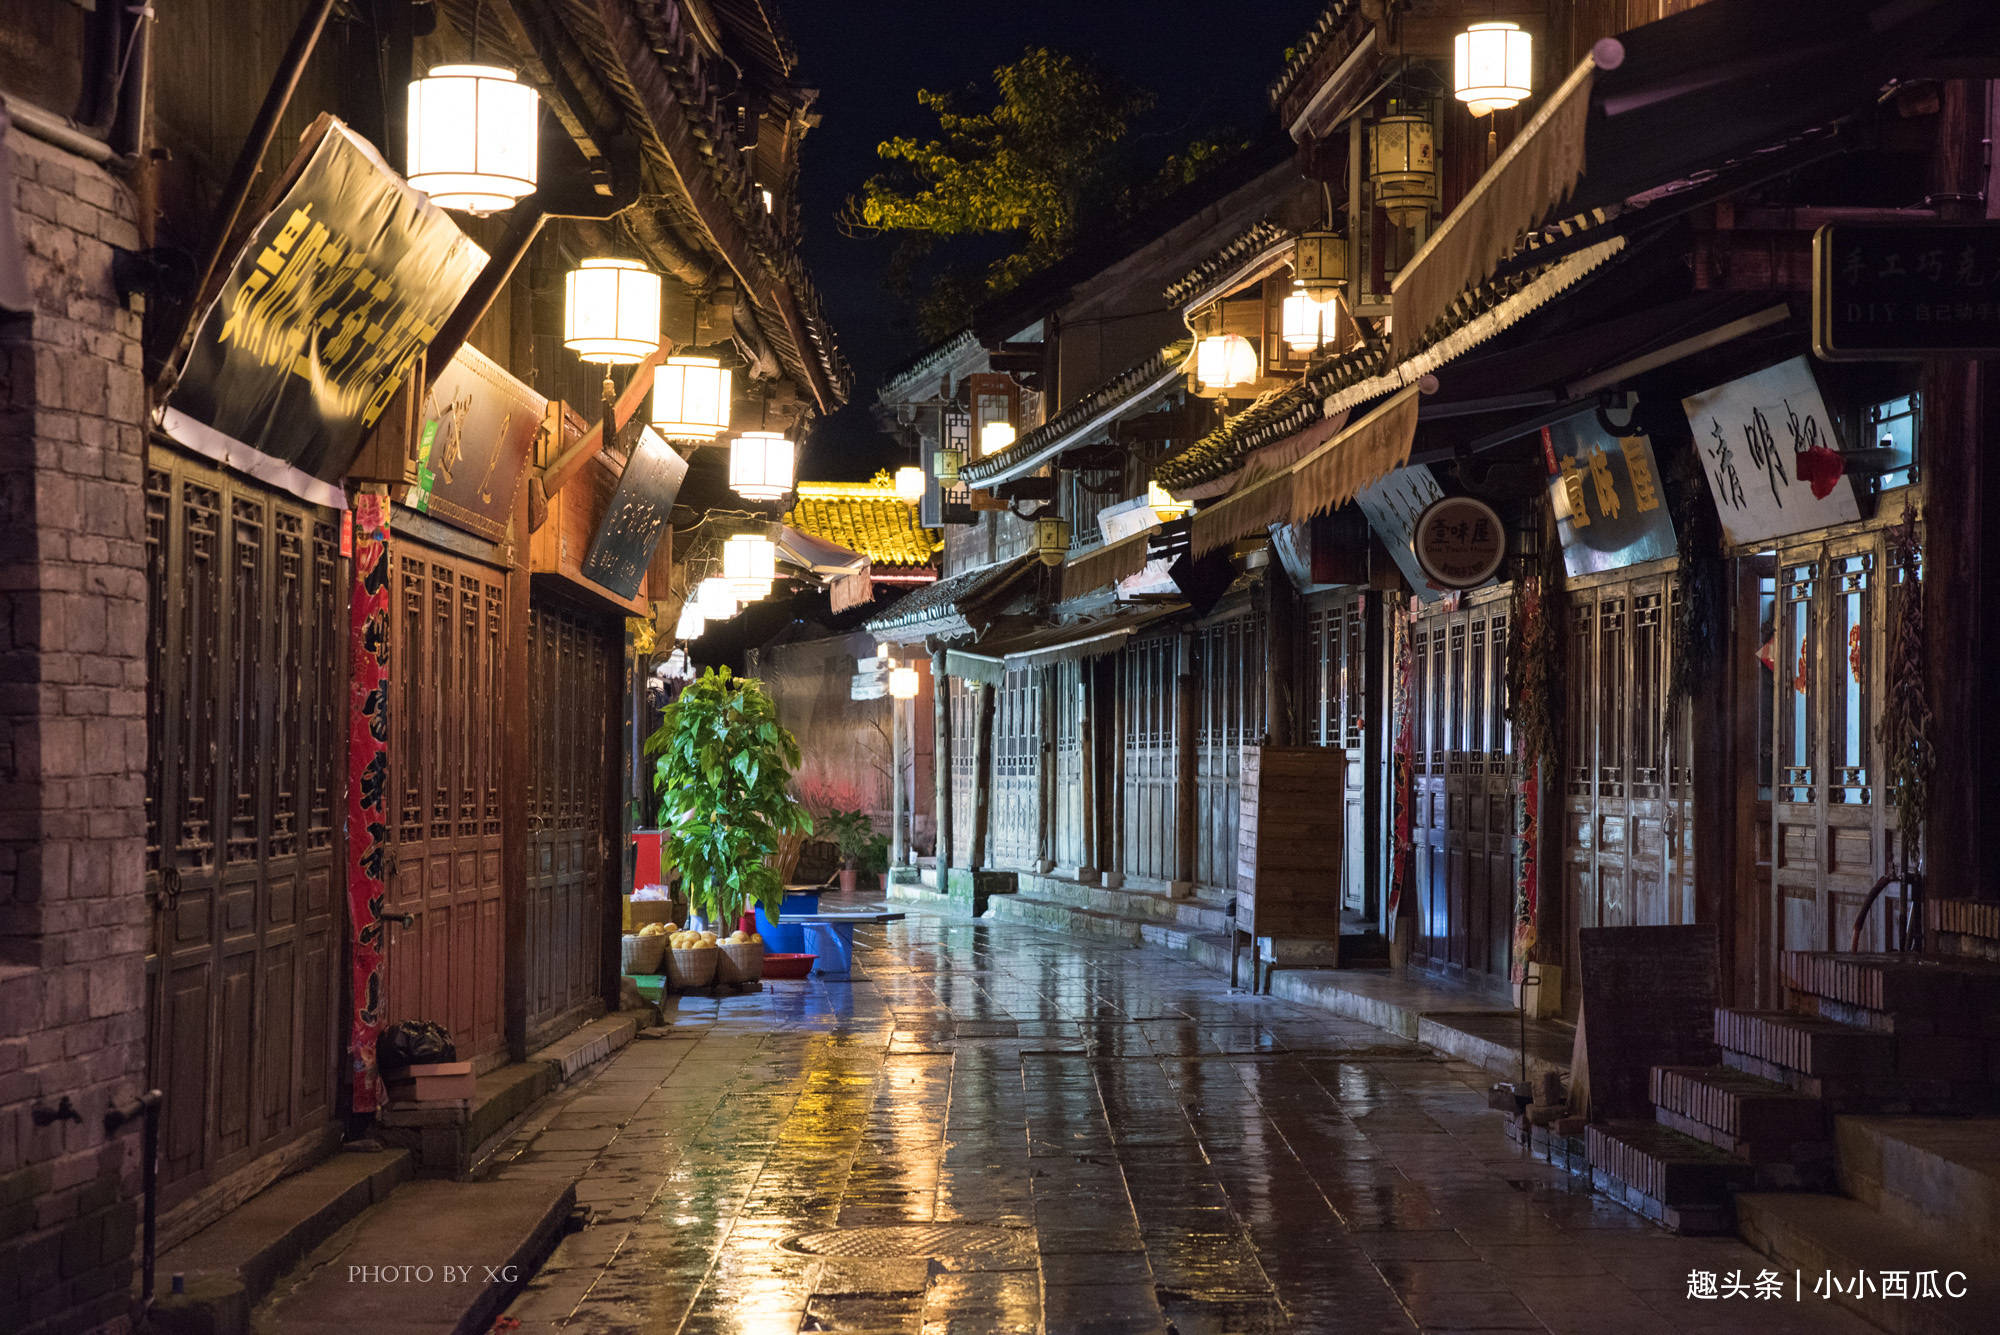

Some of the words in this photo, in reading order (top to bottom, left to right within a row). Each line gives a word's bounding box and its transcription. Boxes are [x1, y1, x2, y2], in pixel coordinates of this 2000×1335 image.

[1842, 247, 2000, 287] 手工巧克
[1916, 303, 2000, 321] 自己动手
